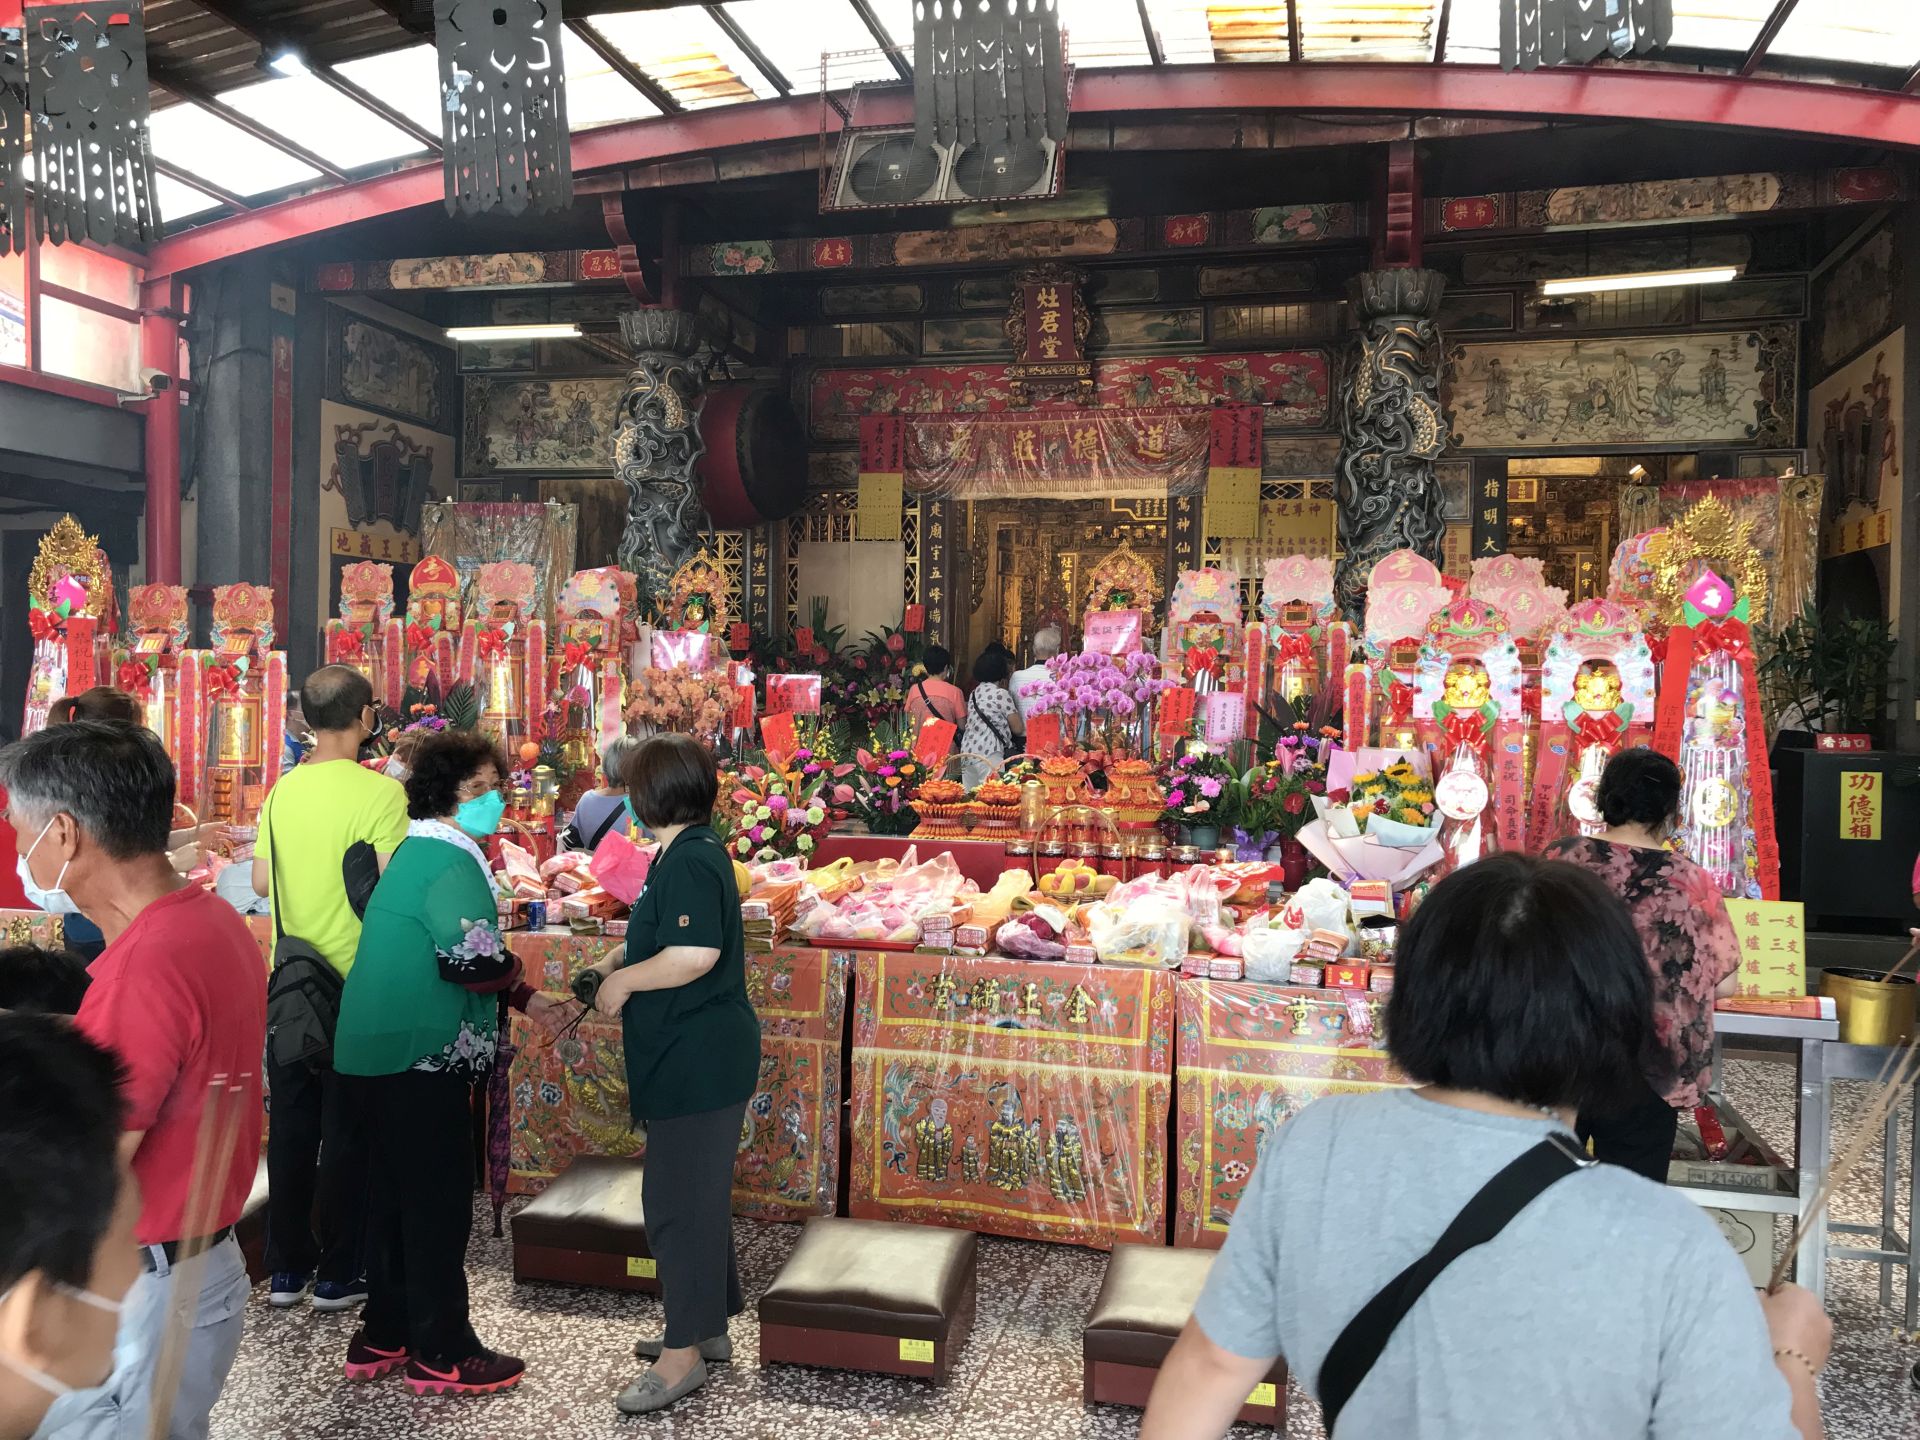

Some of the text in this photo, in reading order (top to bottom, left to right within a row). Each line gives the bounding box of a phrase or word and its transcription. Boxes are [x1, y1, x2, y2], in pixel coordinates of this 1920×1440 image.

[1036, 286, 1063, 360] 灶君堂
[1481, 477, 1501, 553] 指明大
[336, 531, 413, 563] 地藏王菩
[1822, 735, 1866, 749] 香油口
[1504, 794, 1519, 841] 司命真君
[1846, 772, 1876, 840] 功德箱
